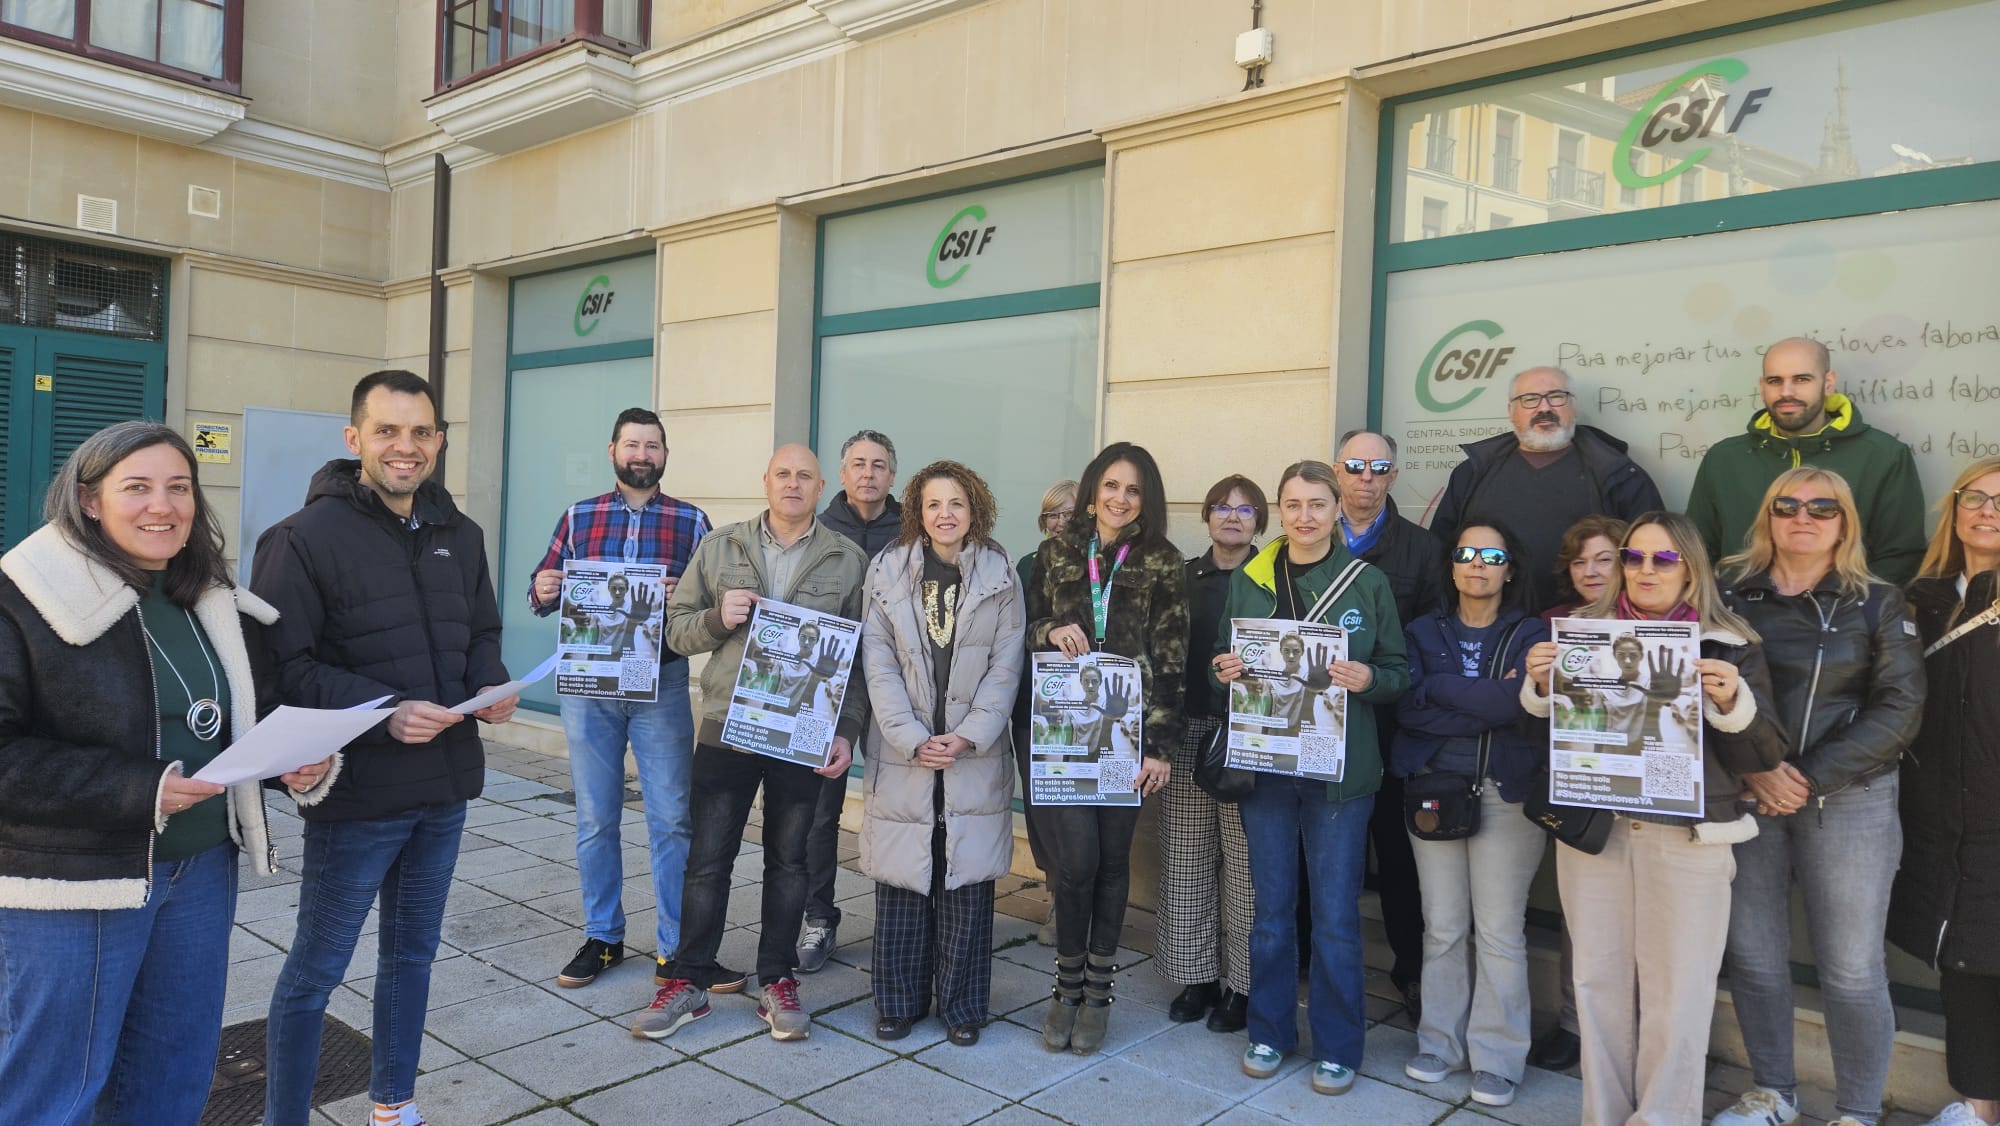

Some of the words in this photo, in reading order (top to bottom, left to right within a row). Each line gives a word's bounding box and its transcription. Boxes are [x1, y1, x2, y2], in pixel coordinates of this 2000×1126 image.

[1556, 342, 1606, 369] Para
[1616, 342, 1696, 375] mejorar
[1703, 339, 1742, 363] tus
[1434, 347, 1516, 382] CSIF
[1598, 386, 1648, 413] Para
[1658, 388, 1743, 421] mejorar
[1406, 429, 1456, 439] CENTRAL
[1659, 432, 1708, 459] Para
[1406, 461, 1420, 470] DE
[764, 630, 784, 640] CSIF
[1246, 648, 1265, 656] CSIF
[1568, 654, 1593, 664] CSIF
[1555, 772, 1568, 780] No
